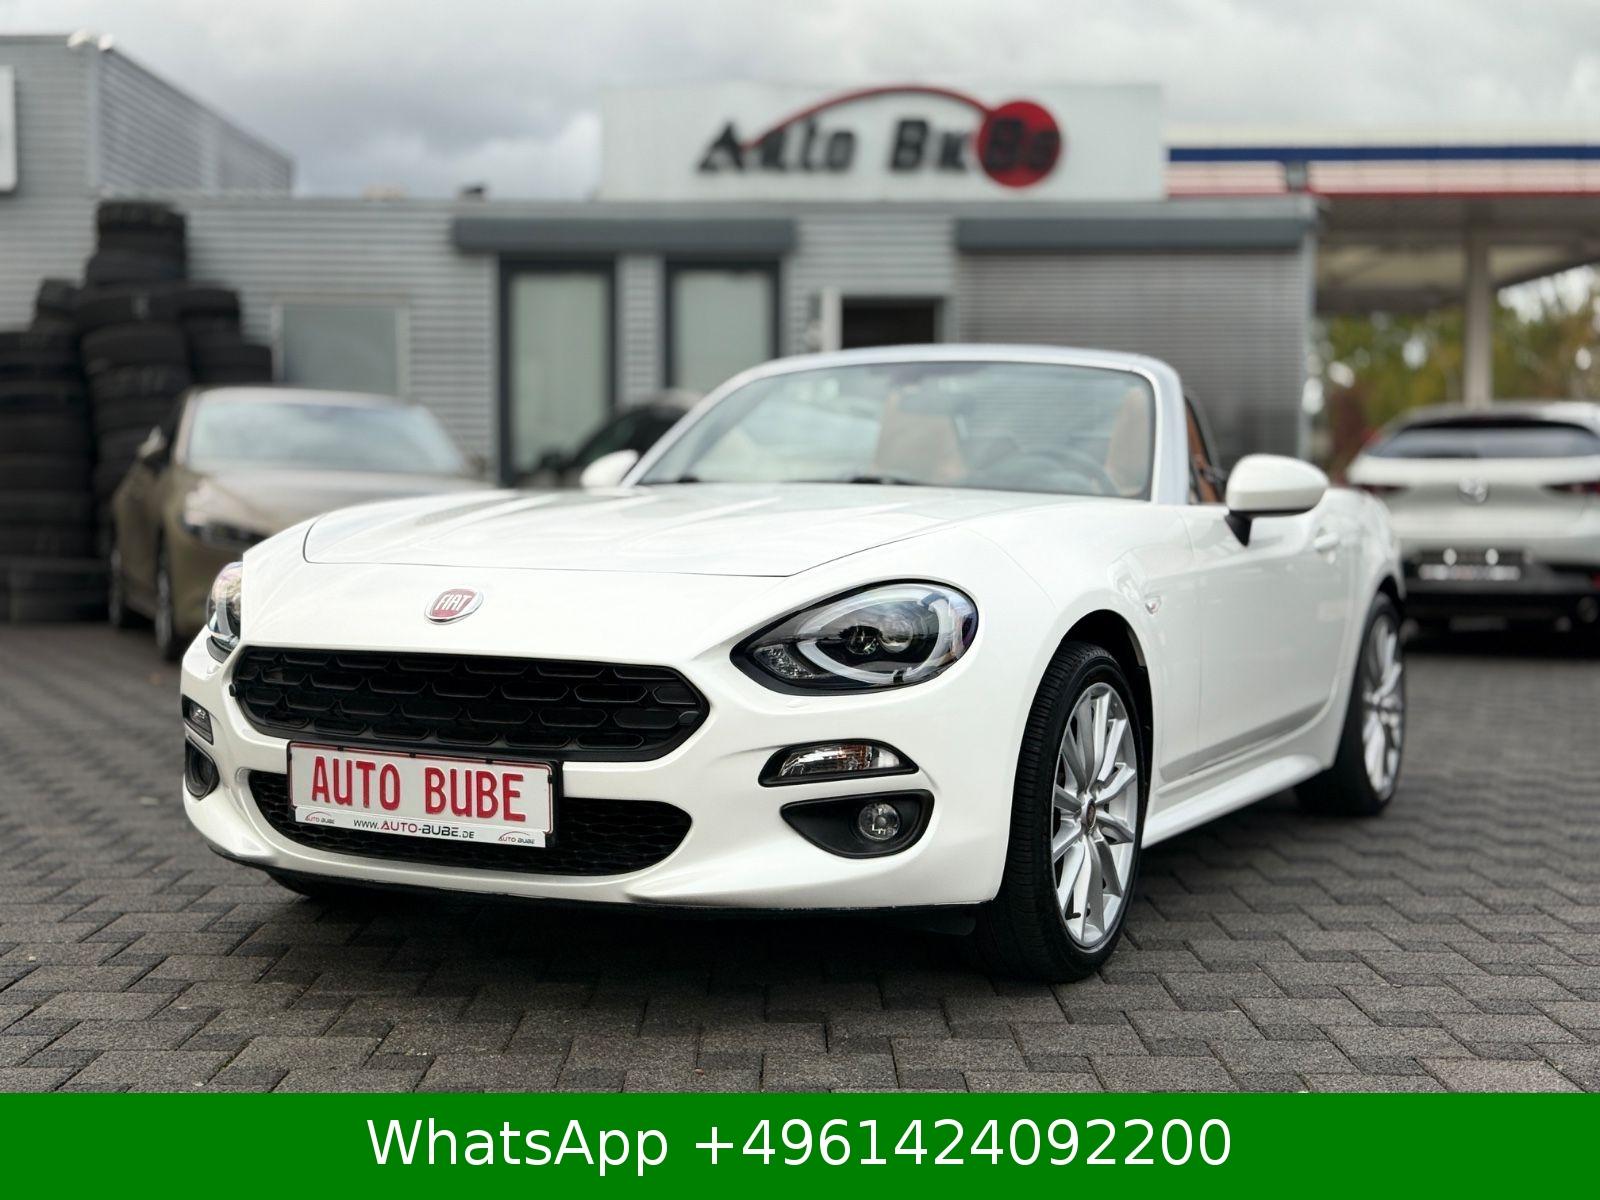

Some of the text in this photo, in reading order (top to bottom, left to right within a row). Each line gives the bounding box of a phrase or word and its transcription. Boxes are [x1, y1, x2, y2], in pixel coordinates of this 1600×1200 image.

[434, 593, 473, 611] FIAT
[311, 756, 526, 822] AUTO BUBE
